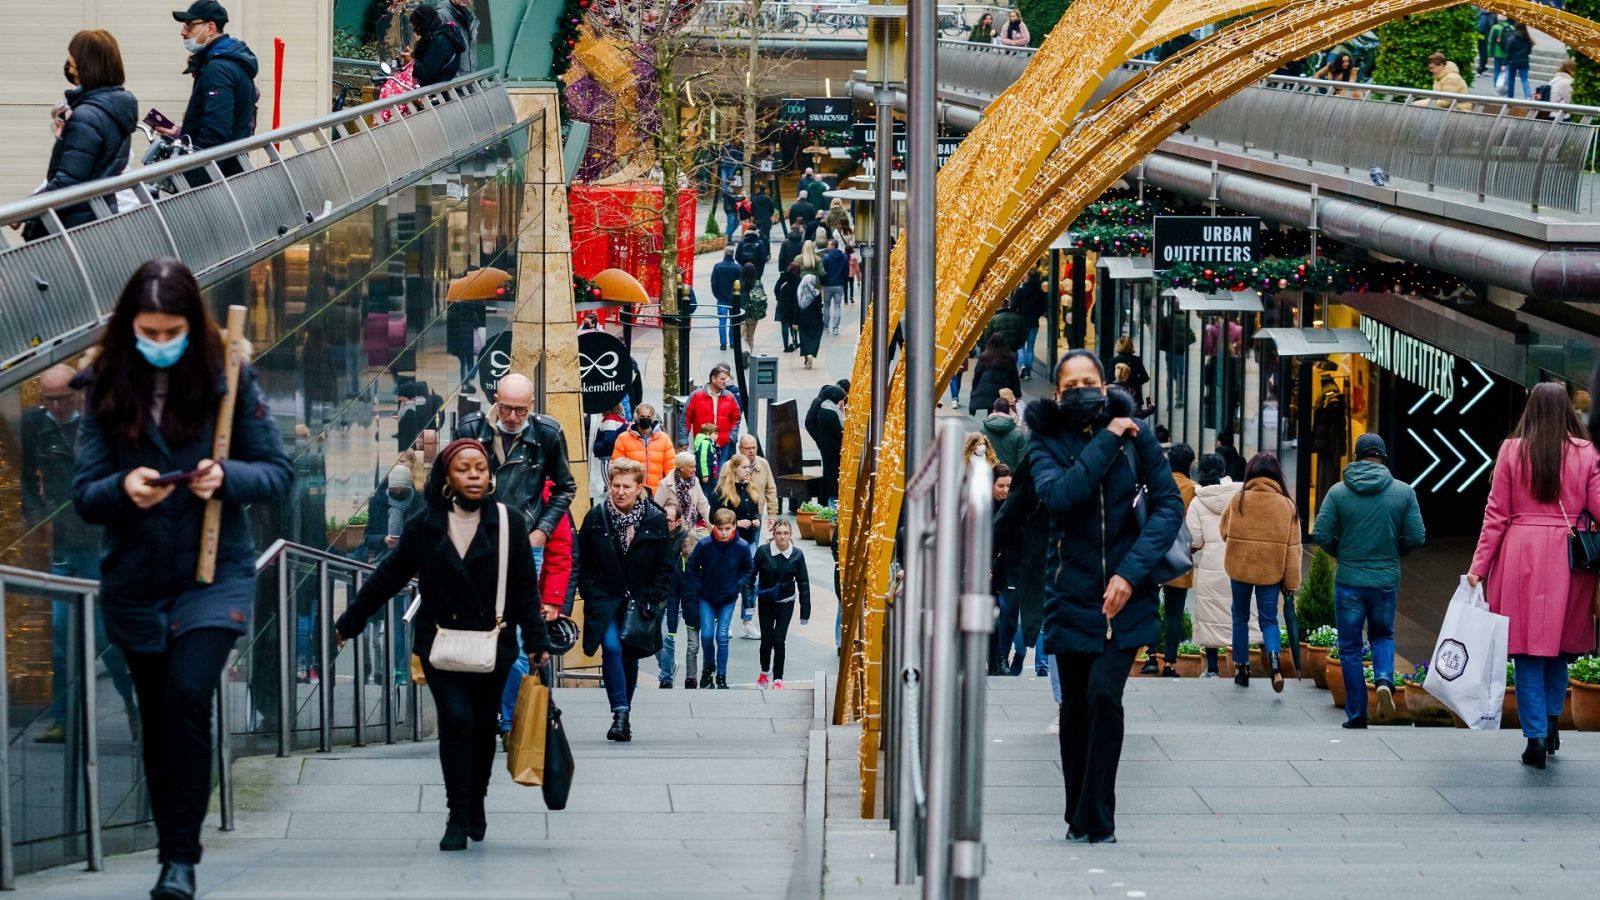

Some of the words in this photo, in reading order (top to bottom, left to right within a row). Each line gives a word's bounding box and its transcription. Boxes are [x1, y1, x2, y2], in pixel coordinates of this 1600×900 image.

[809, 114, 848, 122] SWAROVSKI
[938, 144, 957, 154] BAN
[1203, 226, 1252, 242] URBAN
[1164, 246, 1251, 262] OUTFITTERS
[1393, 331, 1455, 402] OUTFITTERS
[582, 380, 626, 392] kemöller
